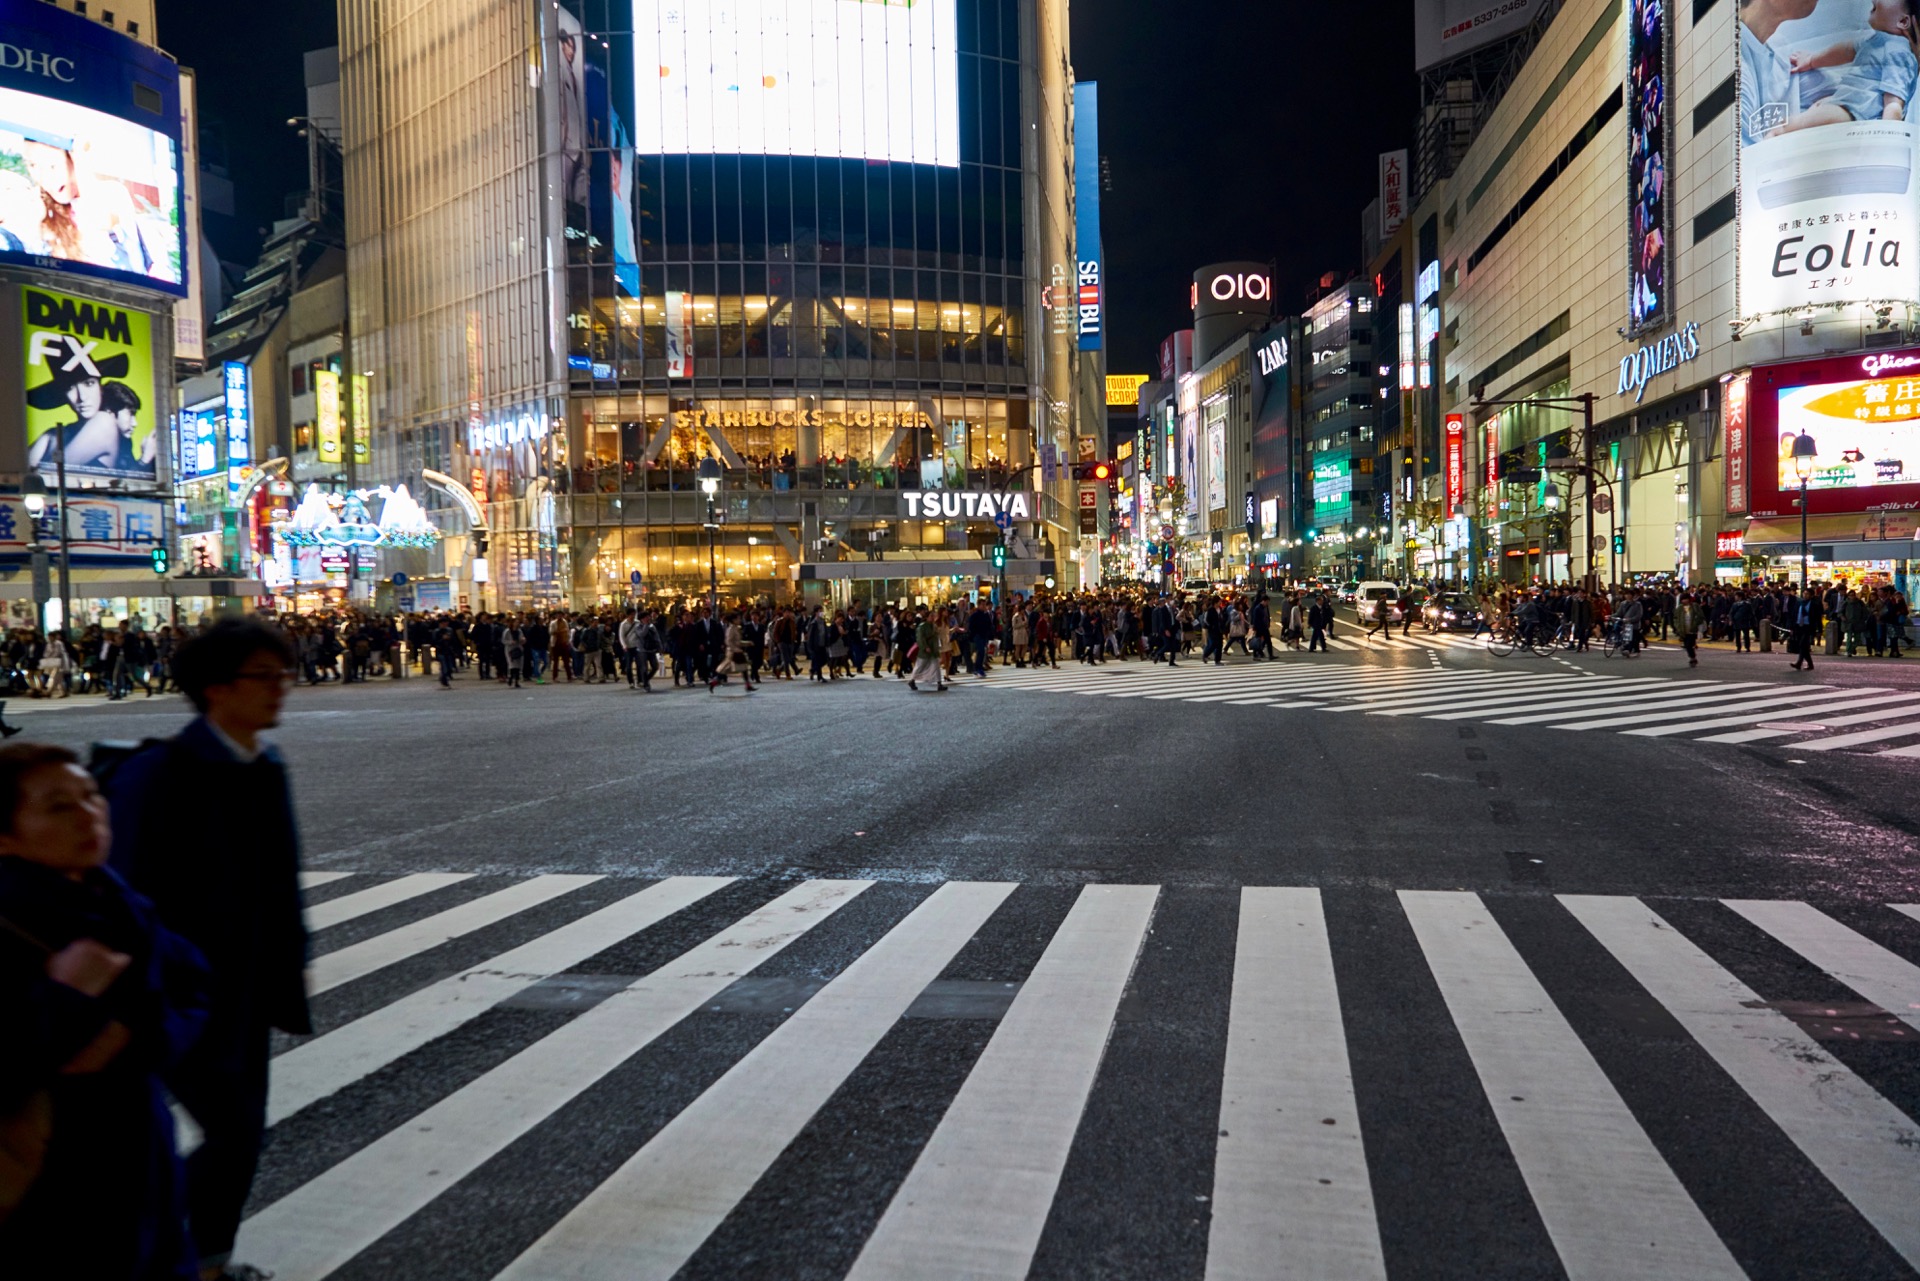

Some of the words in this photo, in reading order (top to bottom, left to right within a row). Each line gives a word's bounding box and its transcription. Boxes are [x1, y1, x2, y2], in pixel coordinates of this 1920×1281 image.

[0, 42, 75, 82] DHC
[1386, 157, 1401, 219] 大和証券
[1778, 210, 1899, 233] 健康な空気と暮らそう
[34, 256, 64, 269] DHC
[1771, 228, 1901, 278] Eolia
[1079, 260, 1100, 334] SEIBU
[26, 289, 133, 346] DMM
[28, 331, 102, 378] FX
[1257, 337, 1288, 376] ZARA
[1862, 354, 1920, 377] Glico
[1106, 377, 1136, 390] TOWER
[675, 409, 824, 428] STARBUCKS
[838, 409, 926, 428] COFFEE
[1137, 429, 1145, 471] KARAOKE
[1729, 385, 1746, 510] 天津甘栗
[903, 492, 1029, 517] TSUTAYA
[1246, 496, 1254, 523] ZARA
[1265, 552, 1278, 563] ZARA
